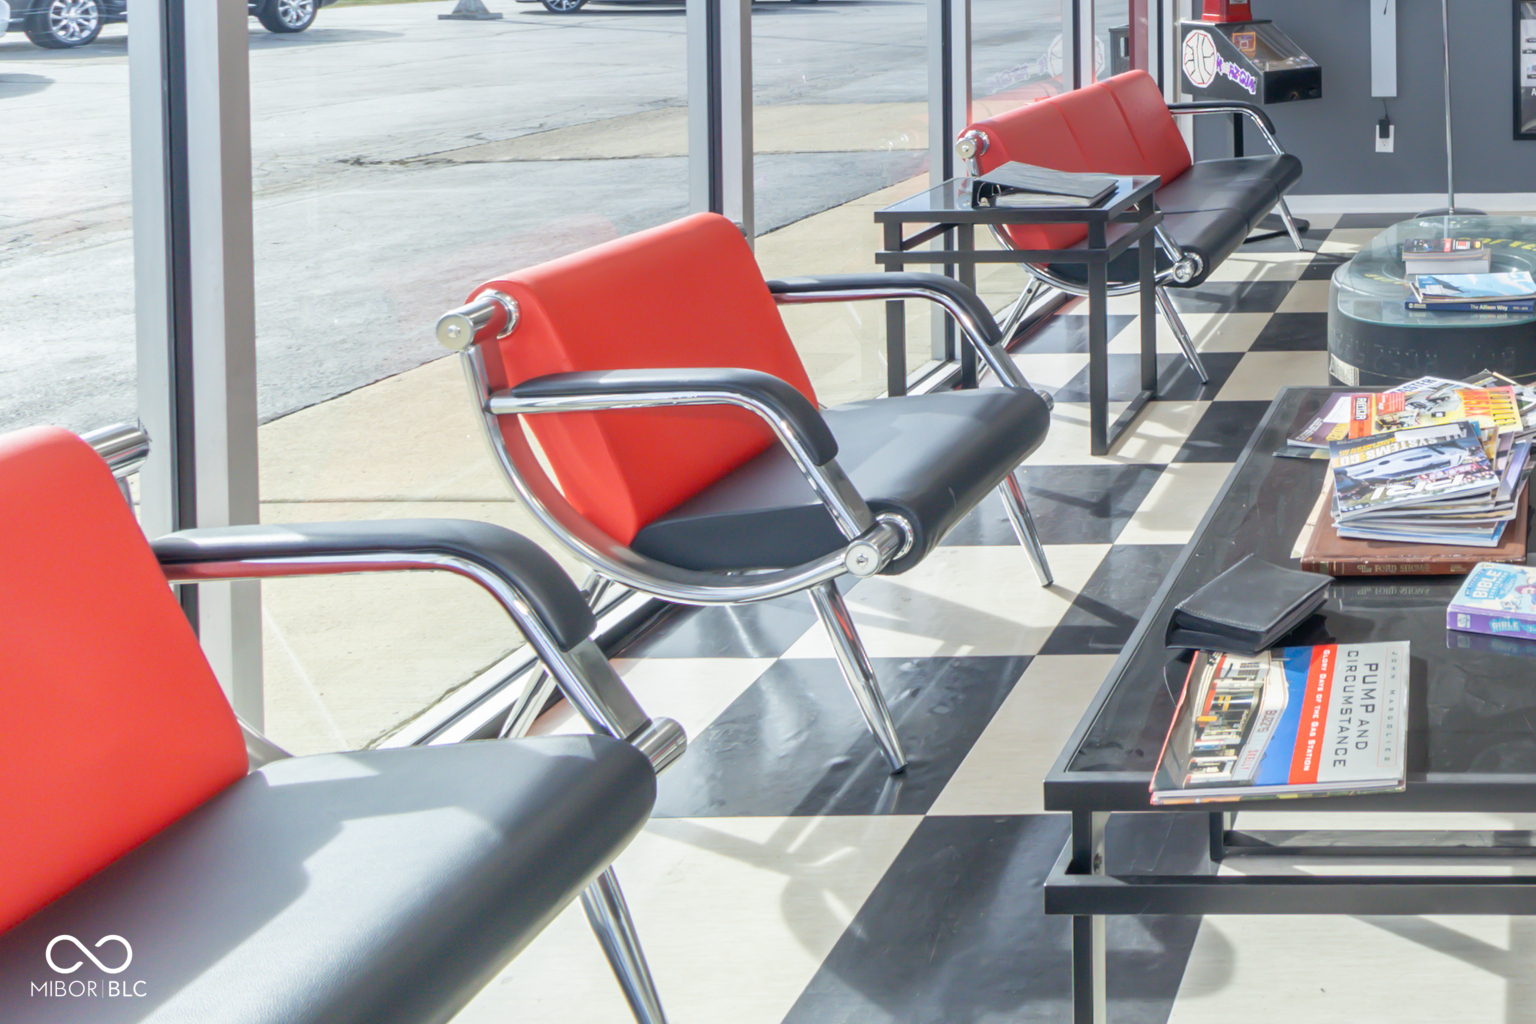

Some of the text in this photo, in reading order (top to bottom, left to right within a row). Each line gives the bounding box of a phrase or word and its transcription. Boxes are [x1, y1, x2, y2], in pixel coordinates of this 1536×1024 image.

[1365, 436, 1438, 460] SYSTEMS
[1374, 564, 1397, 573] FORD
[1472, 568, 1502, 599] BIBLE
[1491, 621, 1519, 629] BIBLE
[1332, 650, 1359, 768] CIRCUMSTANCE
[1355, 662, 1379, 751] PUMP AND
[1384, 651, 1398, 762] JOHN MARGOLIES
[1240, 749, 1259, 770] SKELLY
